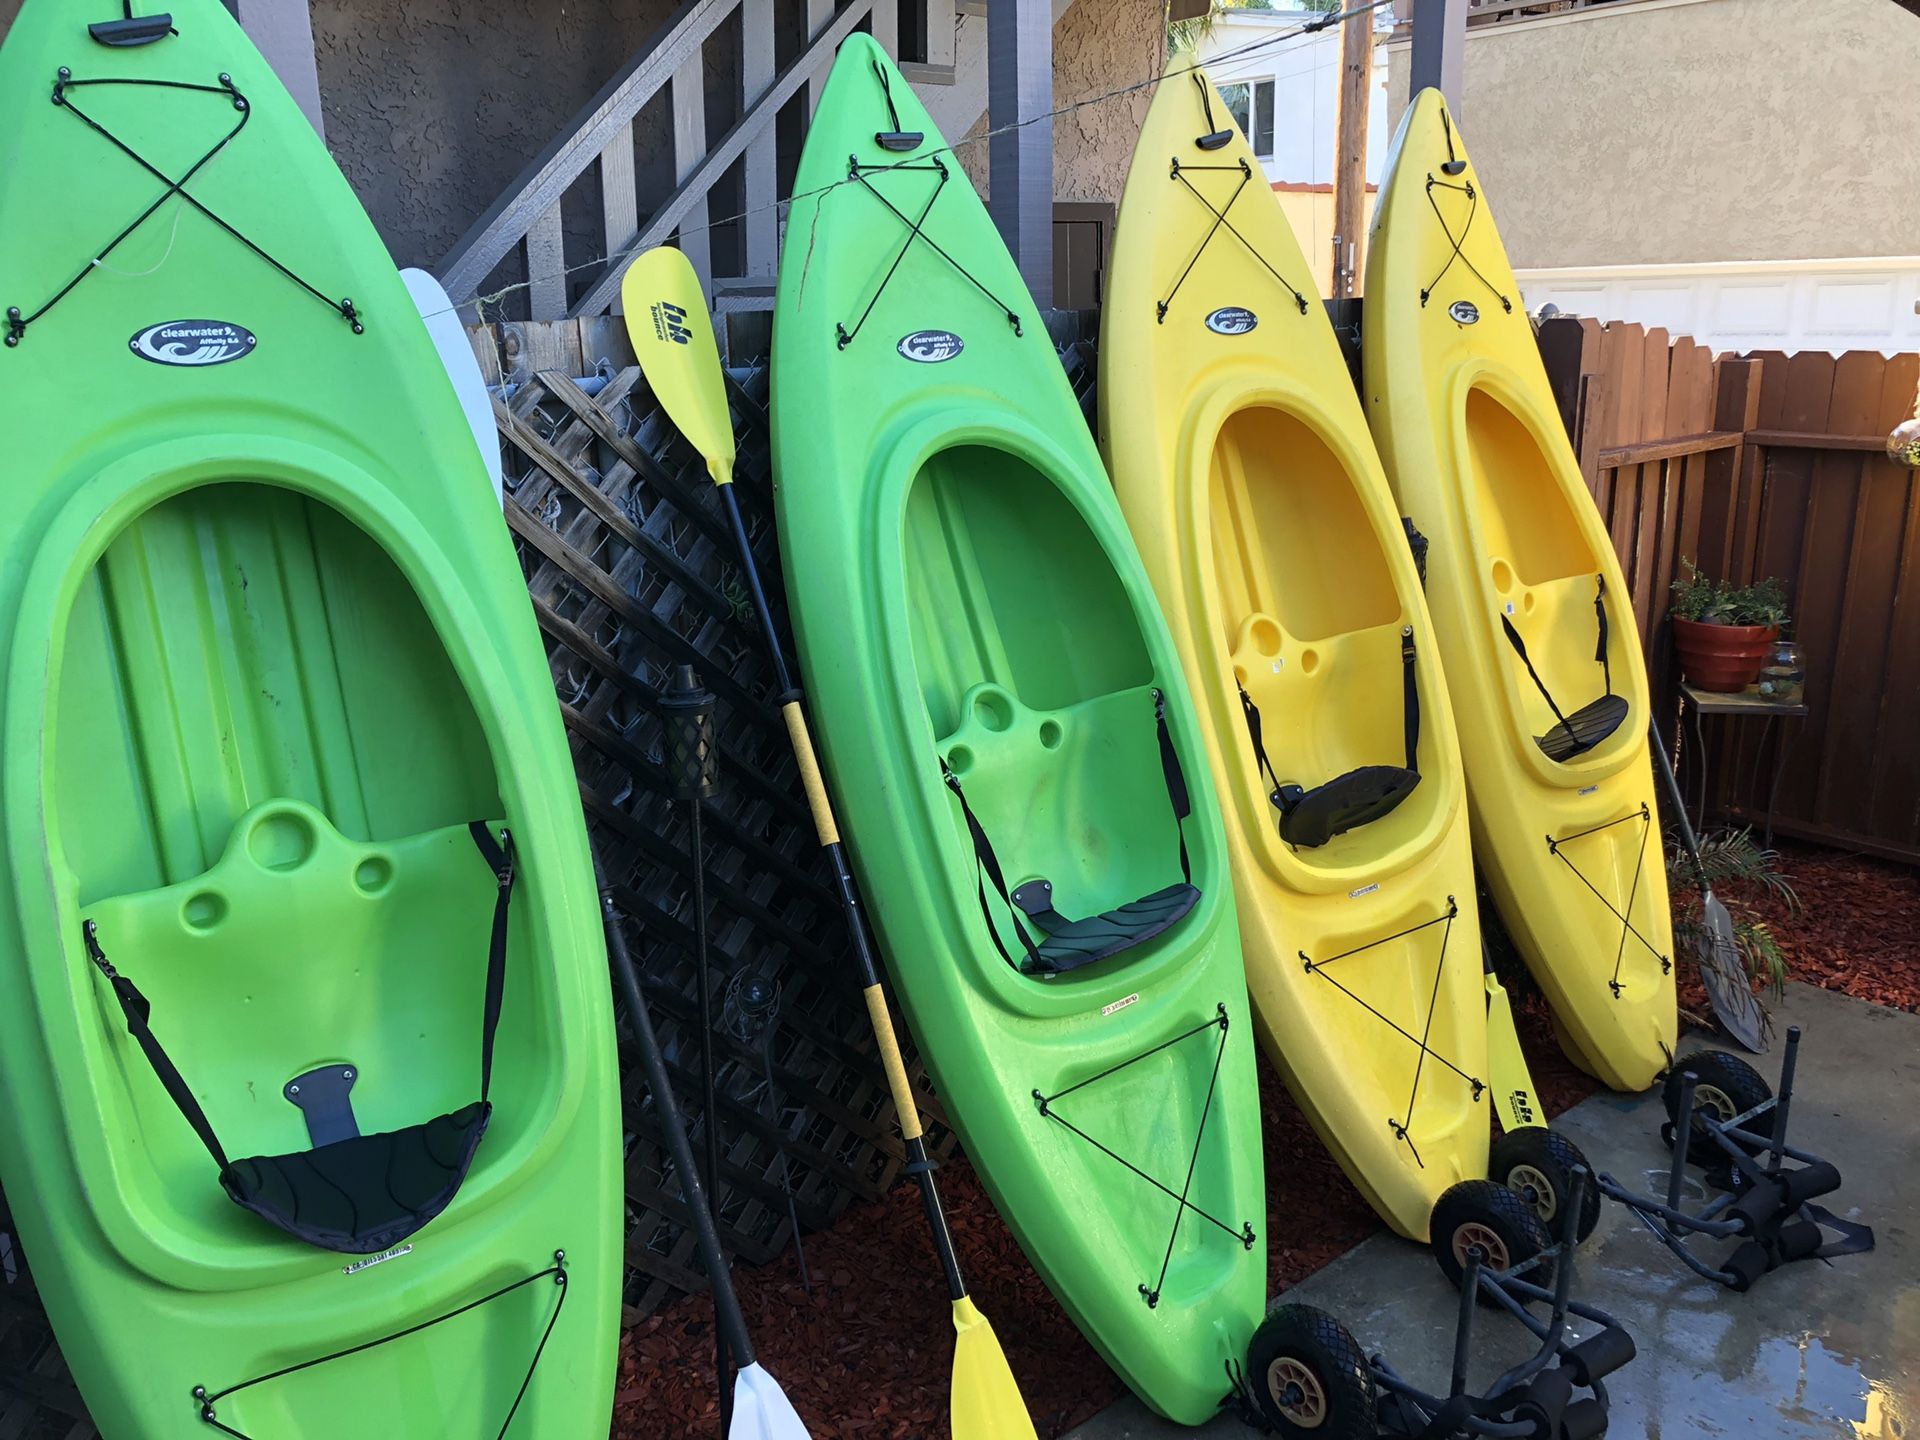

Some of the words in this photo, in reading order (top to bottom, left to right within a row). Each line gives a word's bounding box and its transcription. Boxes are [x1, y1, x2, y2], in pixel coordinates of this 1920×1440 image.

[650, 305, 664, 341] bounce
[161, 327, 224, 338] clearwater
[912, 335, 946, 344] clearwater
